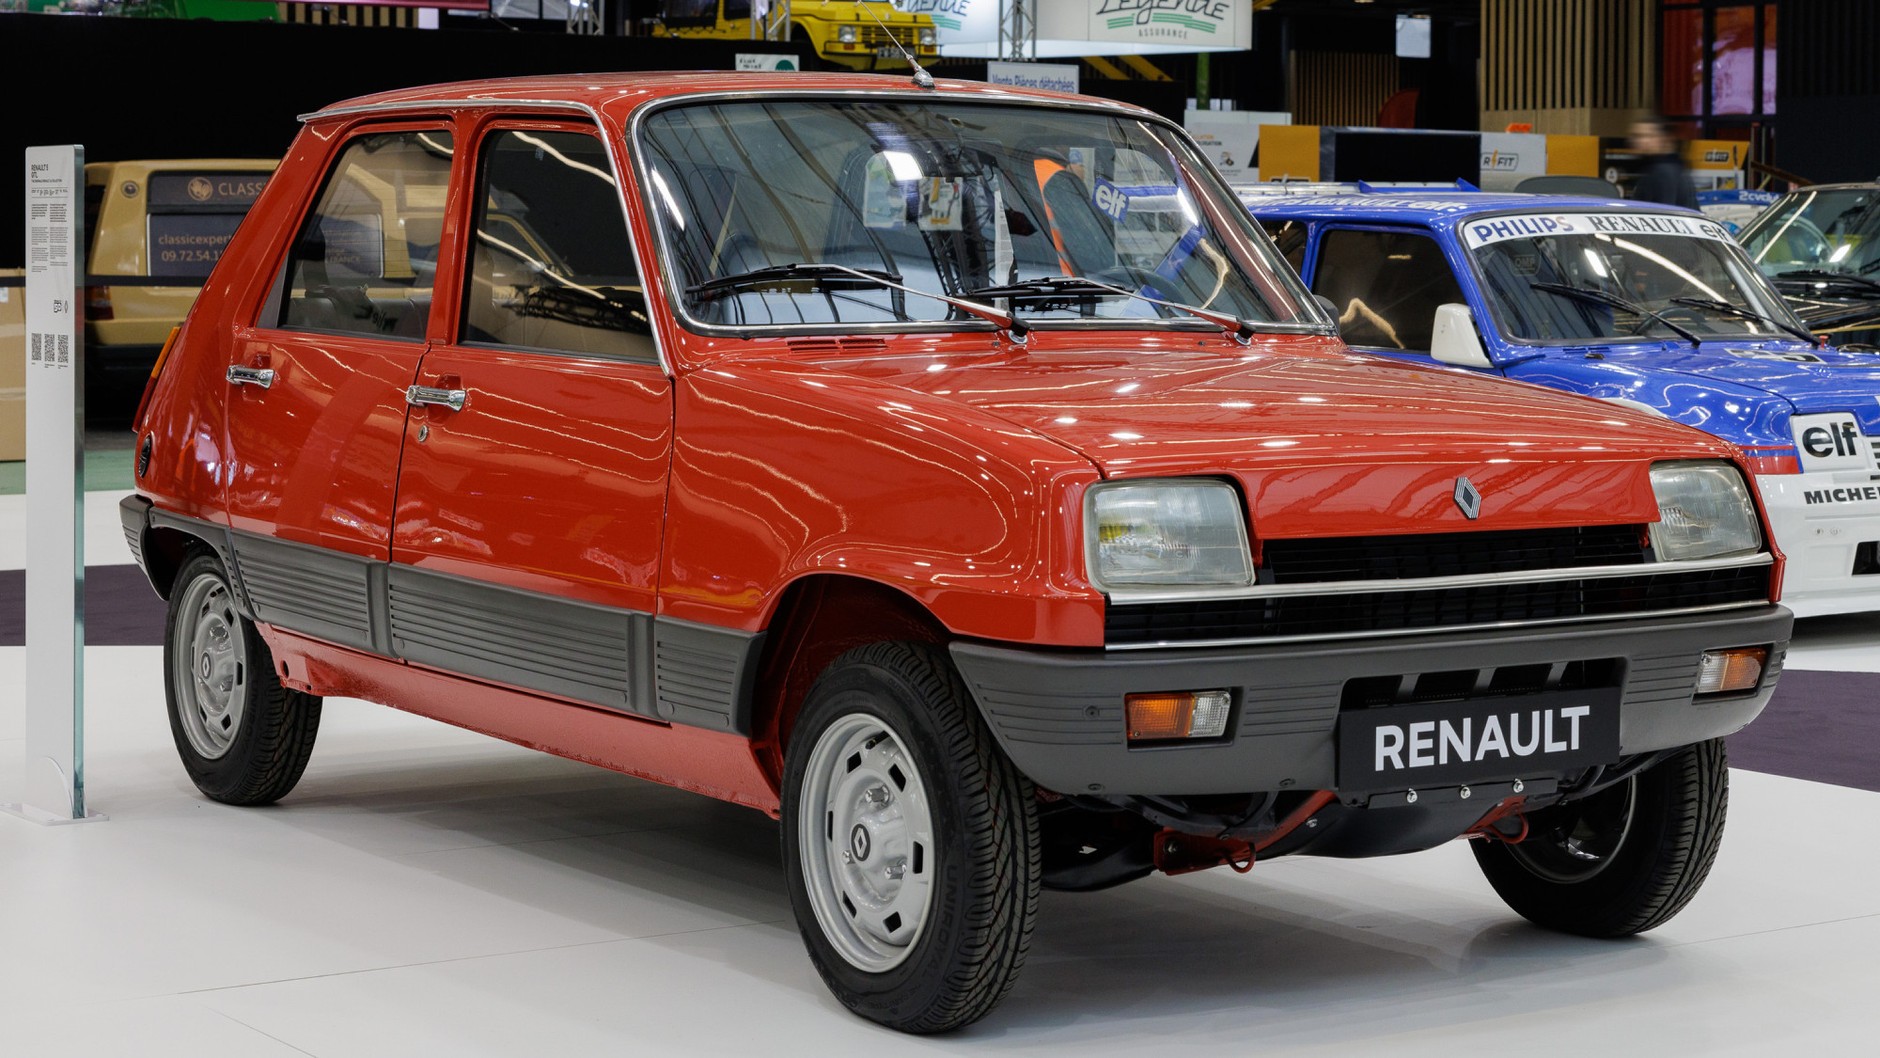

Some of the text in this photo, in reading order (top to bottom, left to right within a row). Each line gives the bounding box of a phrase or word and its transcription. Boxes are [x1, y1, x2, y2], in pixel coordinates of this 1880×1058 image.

[1138, 28, 1188, 40] ASSURANCE
[218, 182, 267, 196] CLASS
[1095, 184, 1127, 219] elf
[1473, 215, 1731, 242] PHILIPS RENAULT elf
[1801, 421, 1858, 458] elf
[1375, 705, 1590, 772] RENAULT
